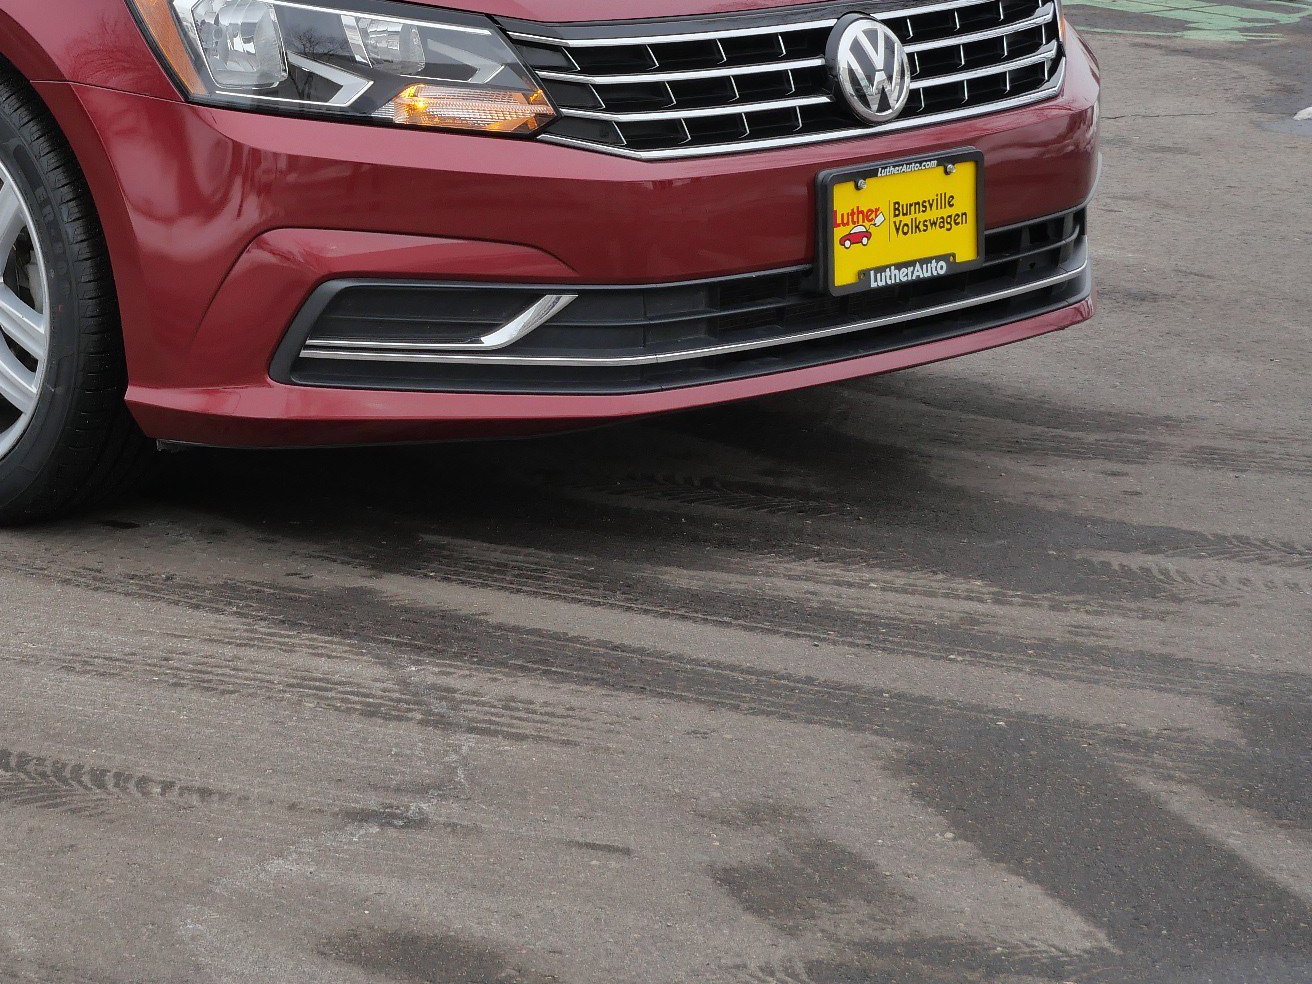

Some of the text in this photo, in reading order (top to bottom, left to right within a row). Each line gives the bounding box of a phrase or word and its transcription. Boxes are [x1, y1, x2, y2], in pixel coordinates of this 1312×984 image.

[877, 160, 938, 177] LutherAuto.com
[833, 205, 881, 228] Luther
[893, 193, 955, 217] Burnsville
[893, 211, 968, 237] Volkswagen
[870, 260, 947, 288] LutherAuto
